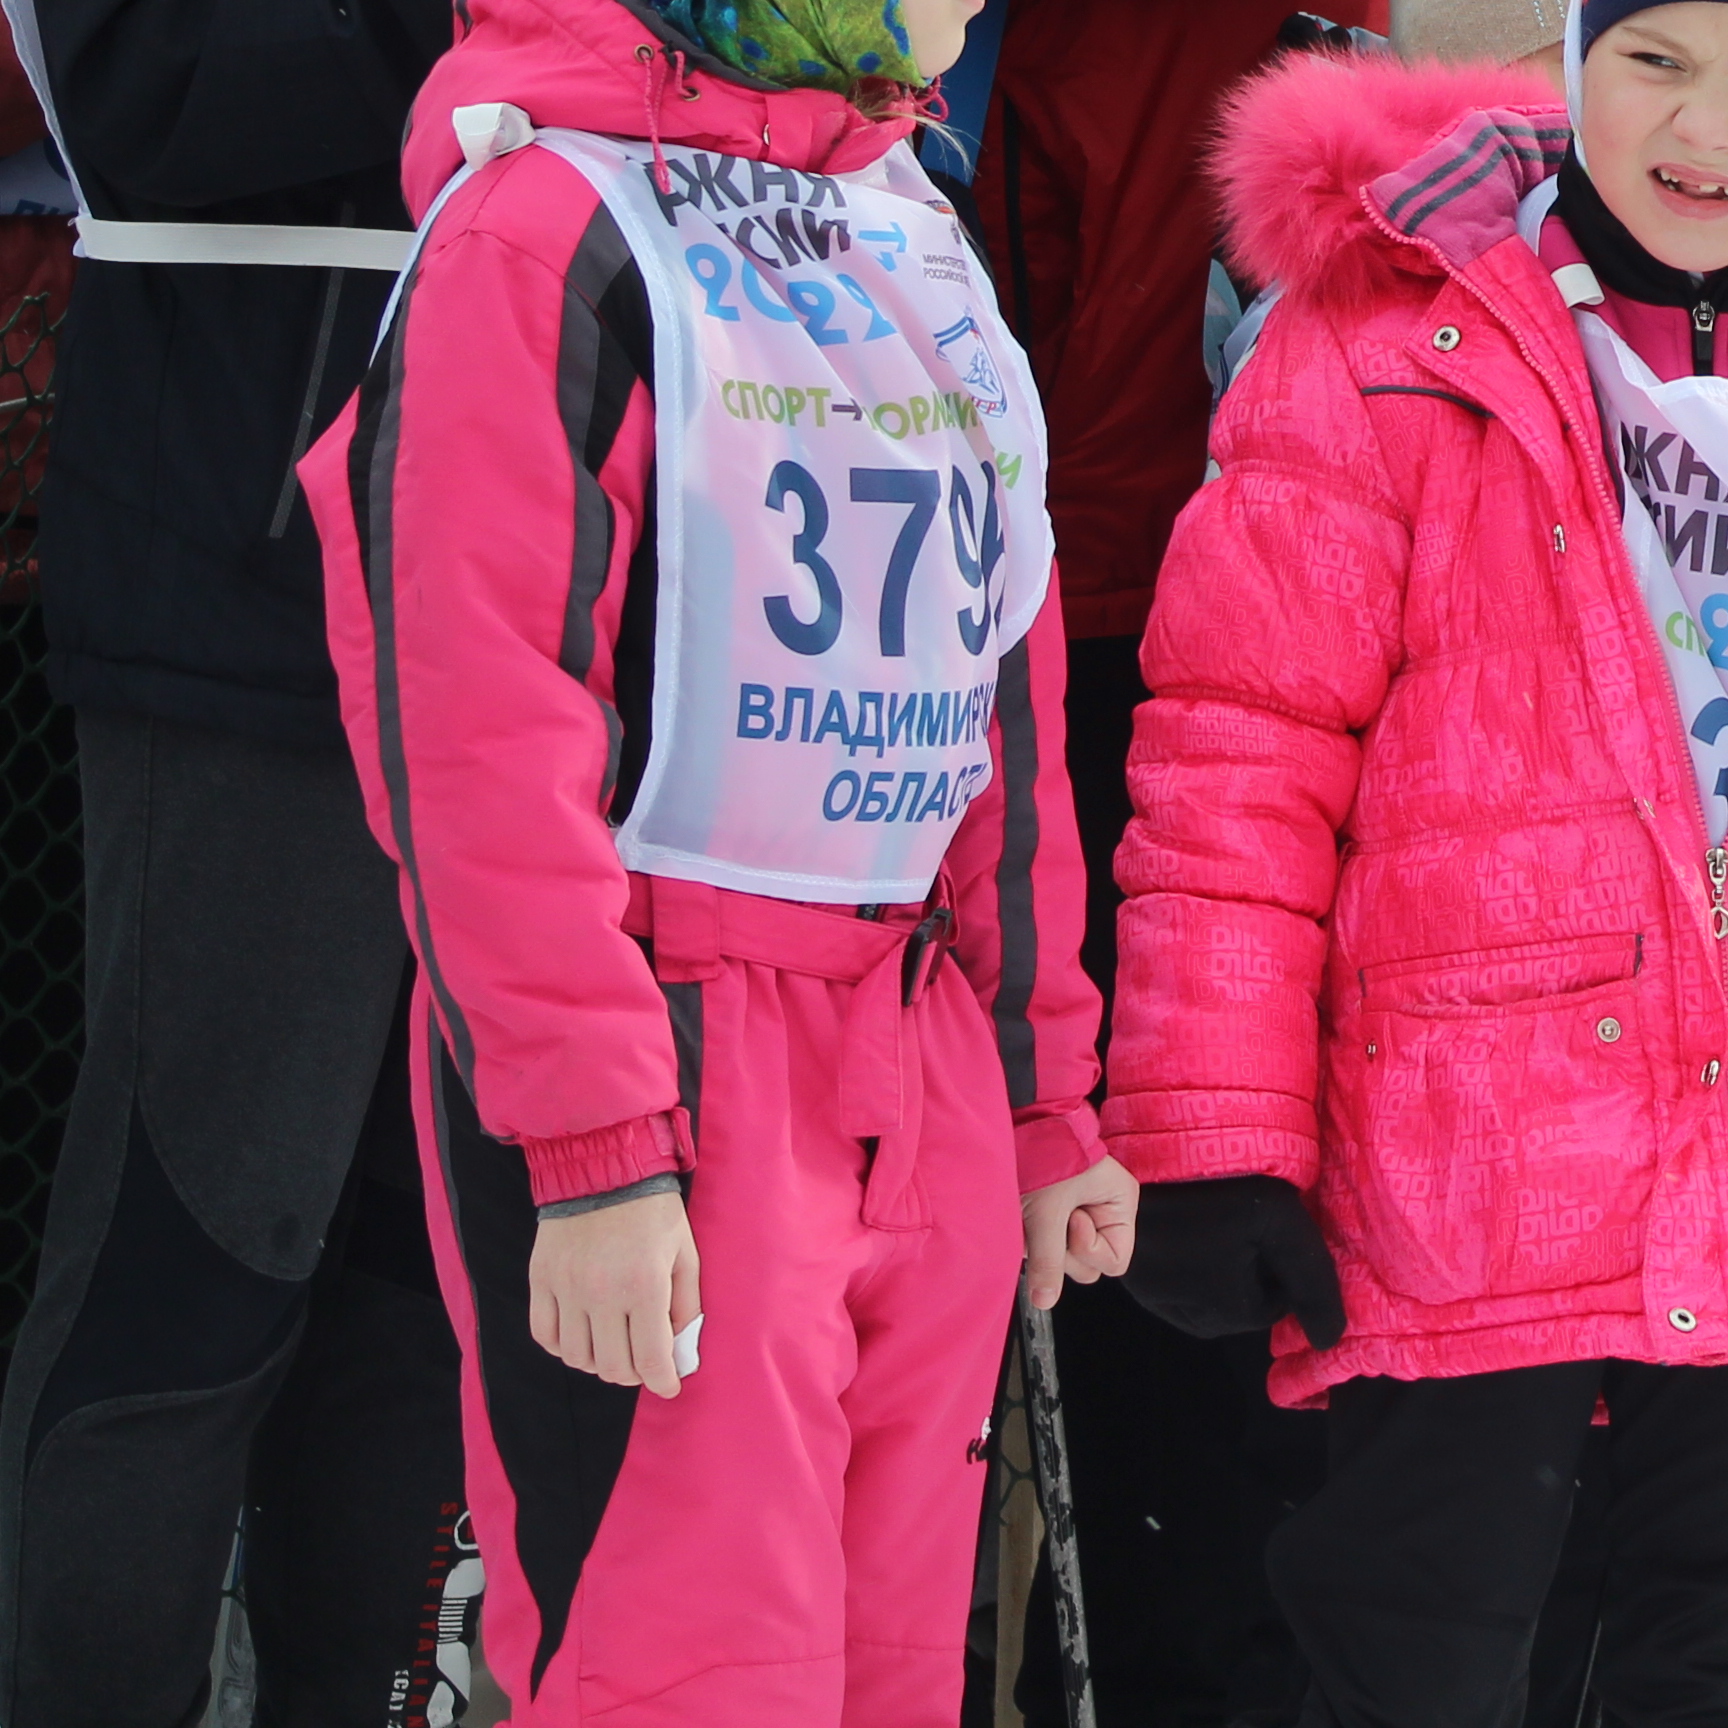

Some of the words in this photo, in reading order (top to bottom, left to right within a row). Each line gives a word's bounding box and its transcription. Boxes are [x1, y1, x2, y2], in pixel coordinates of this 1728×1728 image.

[721, 378, 832, 432] СПОРТ
[763, 458, 1006, 658] 379
[425, 1501, 459, 1589] STILE
